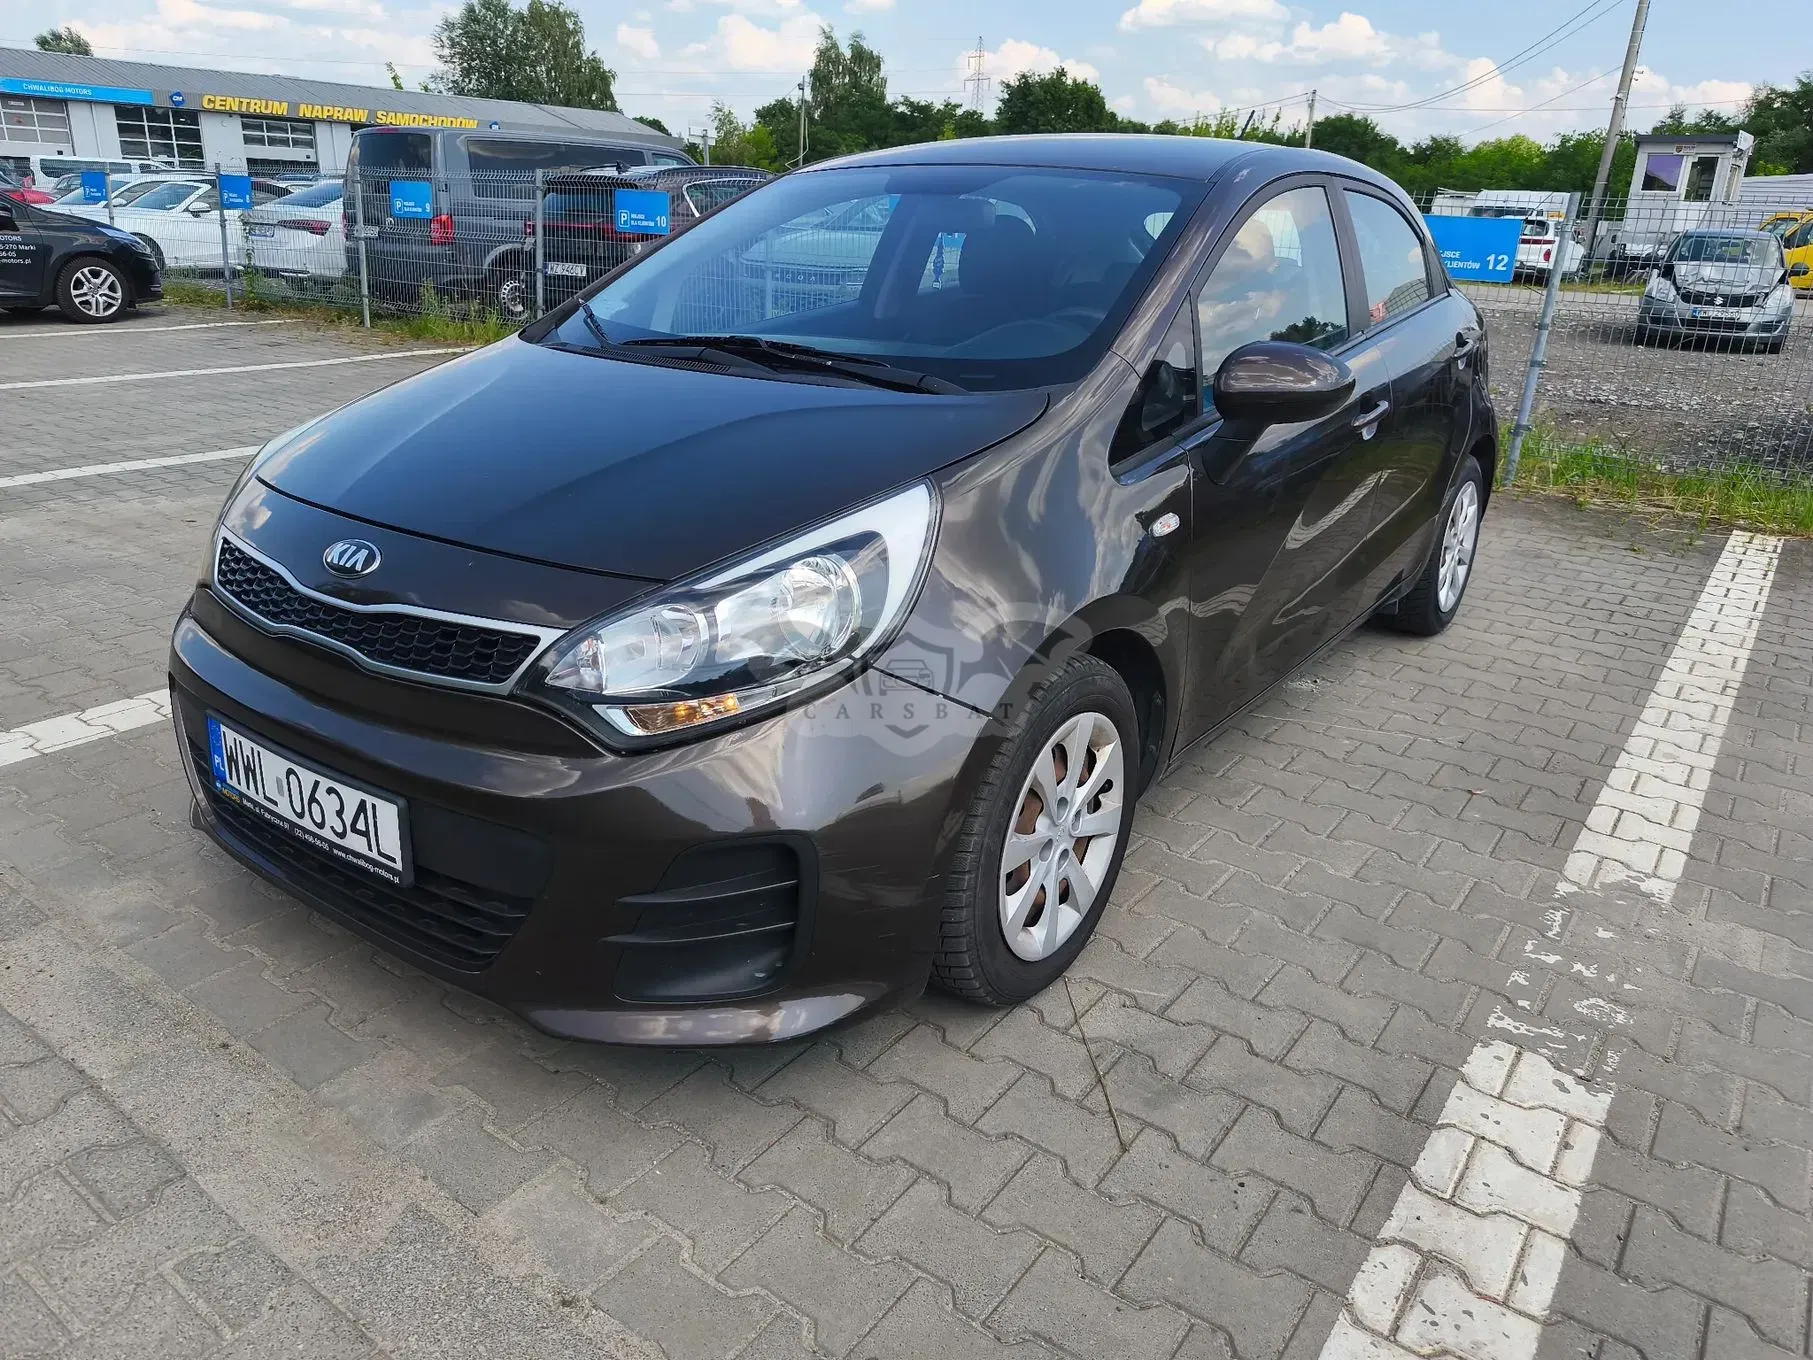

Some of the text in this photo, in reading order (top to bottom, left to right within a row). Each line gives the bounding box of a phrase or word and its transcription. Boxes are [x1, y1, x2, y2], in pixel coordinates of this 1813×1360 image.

[65, 87, 92, 96] MOTORS
[201, 93, 288, 115] CENTRUM
[299, 102, 369, 122] NAPRAW
[655, 215, 667, 228] 10
[1485, 253, 1510, 271] 12
[214, 755, 225, 772] PL
[222, 730, 398, 866] WWL 0634L
